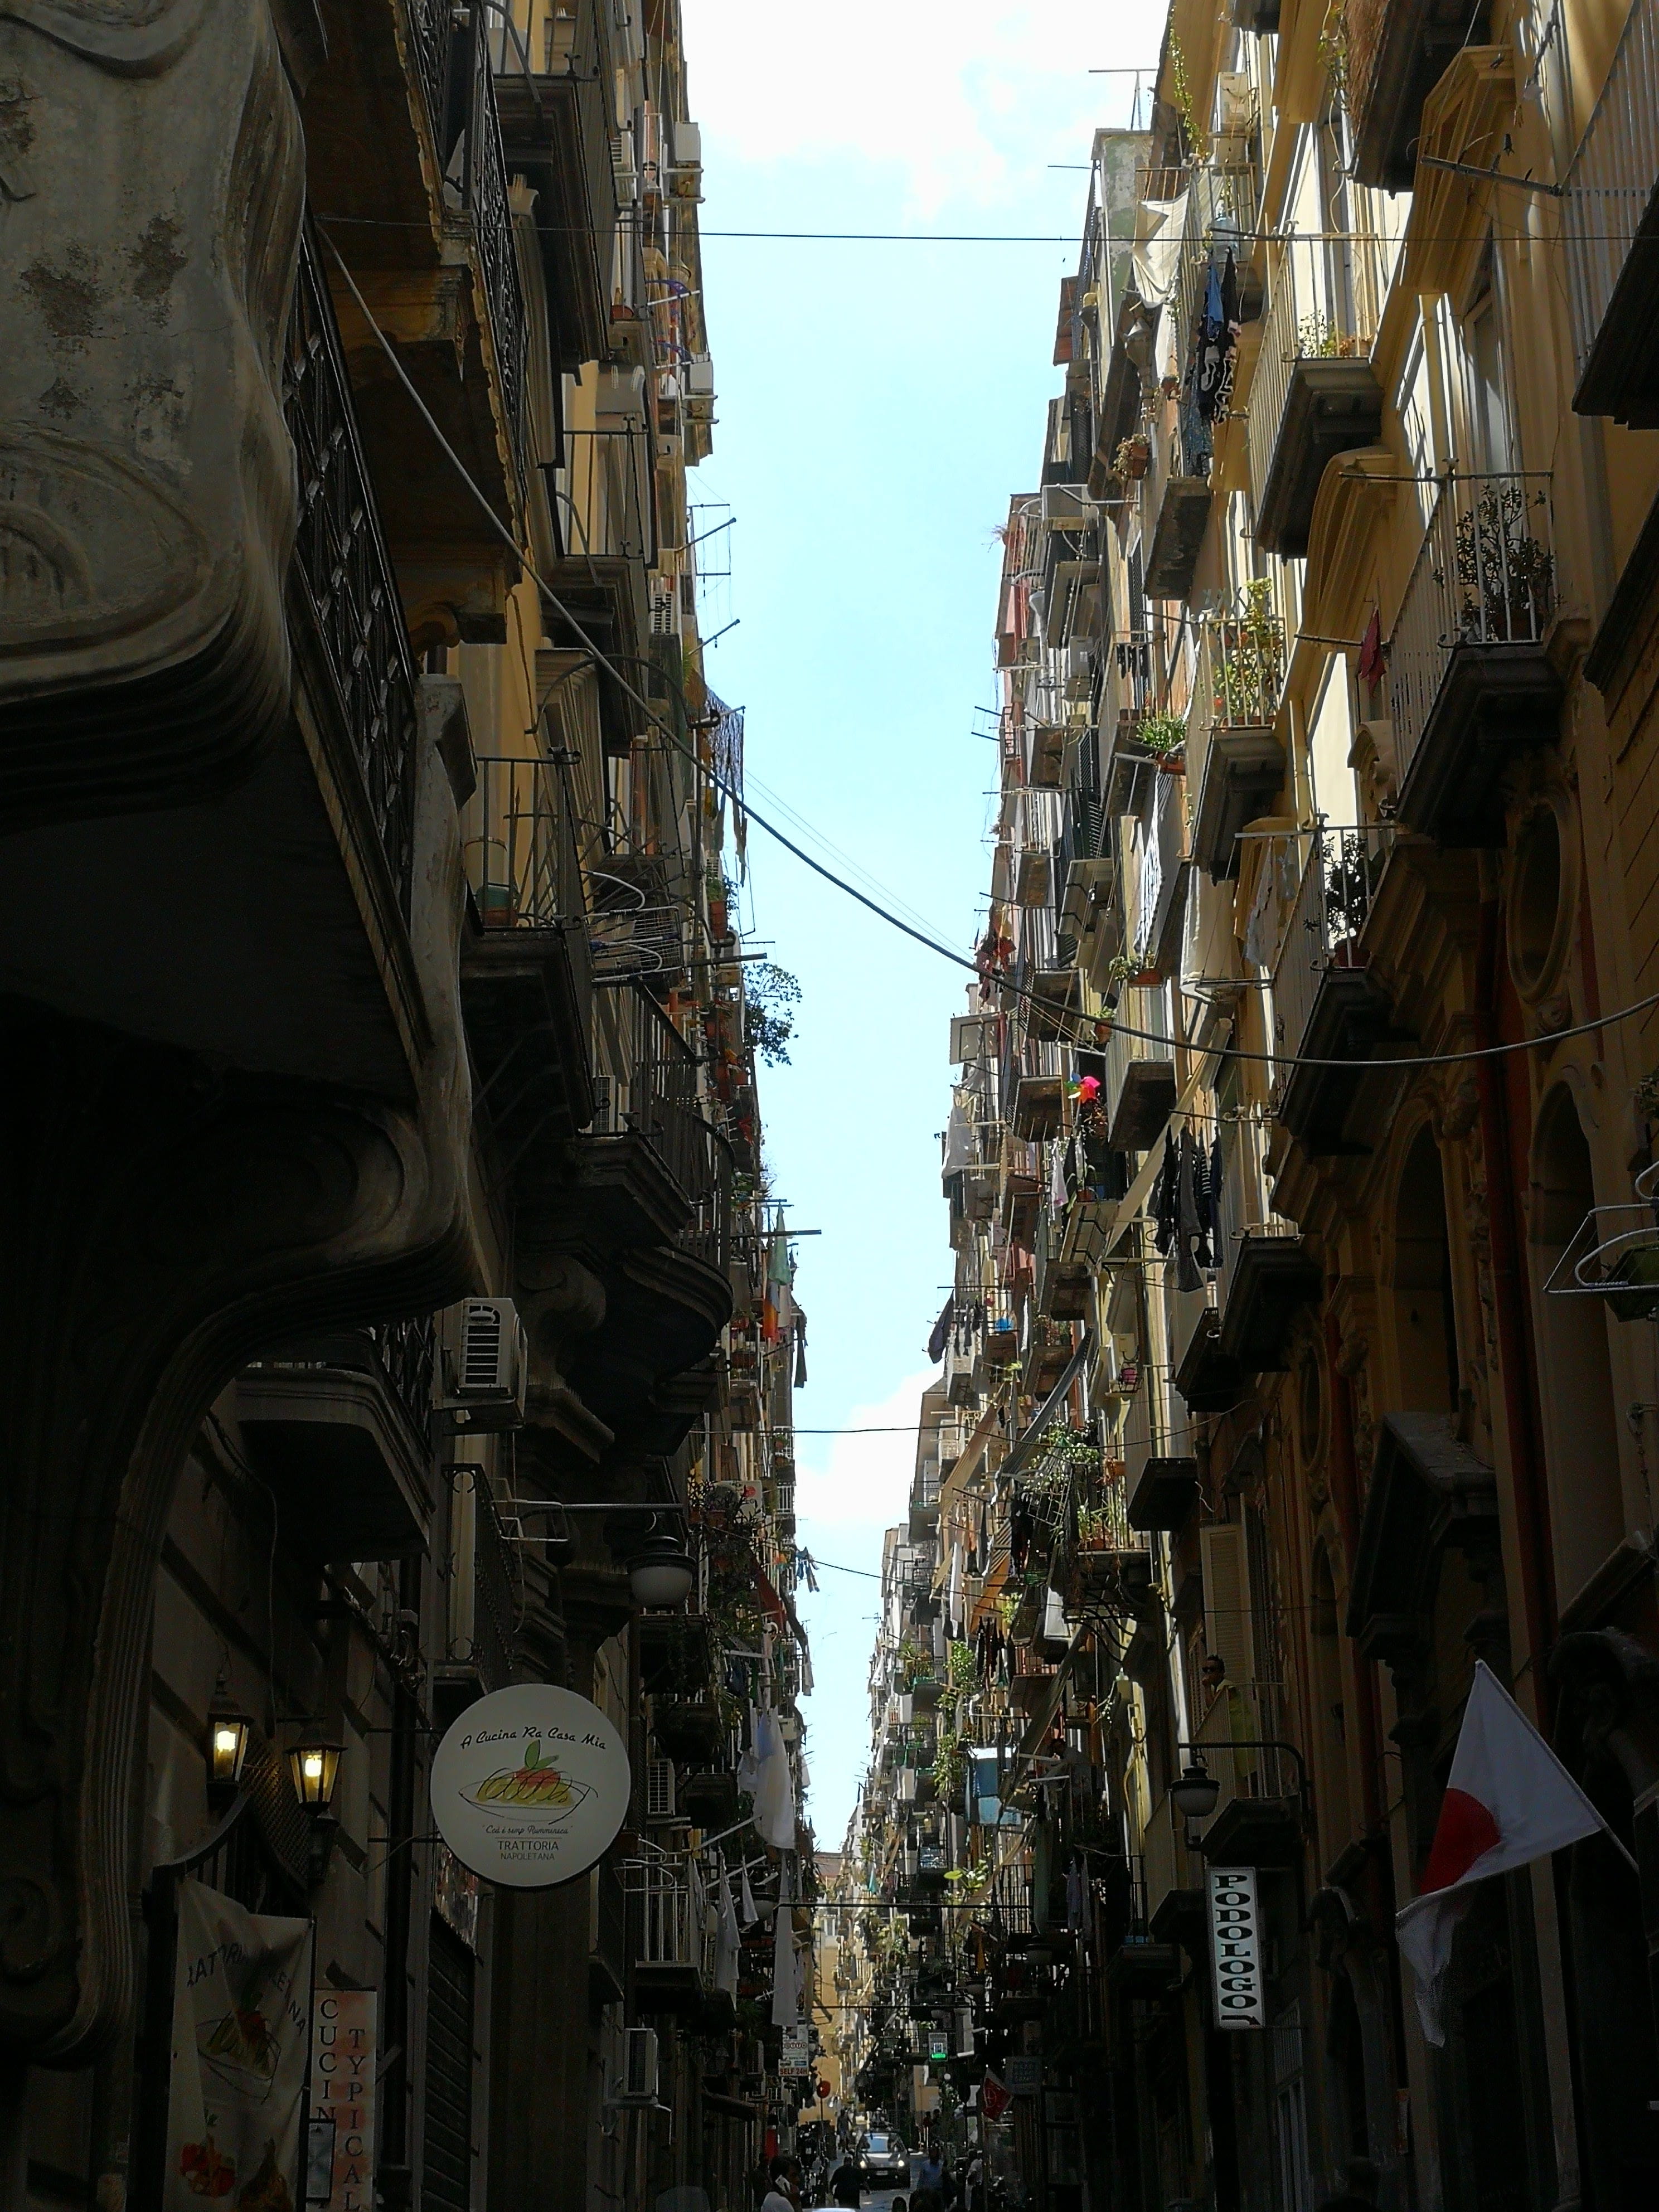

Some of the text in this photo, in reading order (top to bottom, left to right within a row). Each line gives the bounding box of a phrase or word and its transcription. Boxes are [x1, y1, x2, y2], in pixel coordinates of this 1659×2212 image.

[460, 1735, 472, 1749] A
[476, 1729, 517, 1744] Cucina
[548, 1727, 576, 1741] Casa
[581, 1734, 606, 1749] Mia
[497, 1841, 559, 1851] TRATTORIA
[1214, 1874, 1258, 2010] PODOLOGO
[317, 1998, 339, 2119] CUCIN
[343, 2029, 366, 2211] TYPICAL
